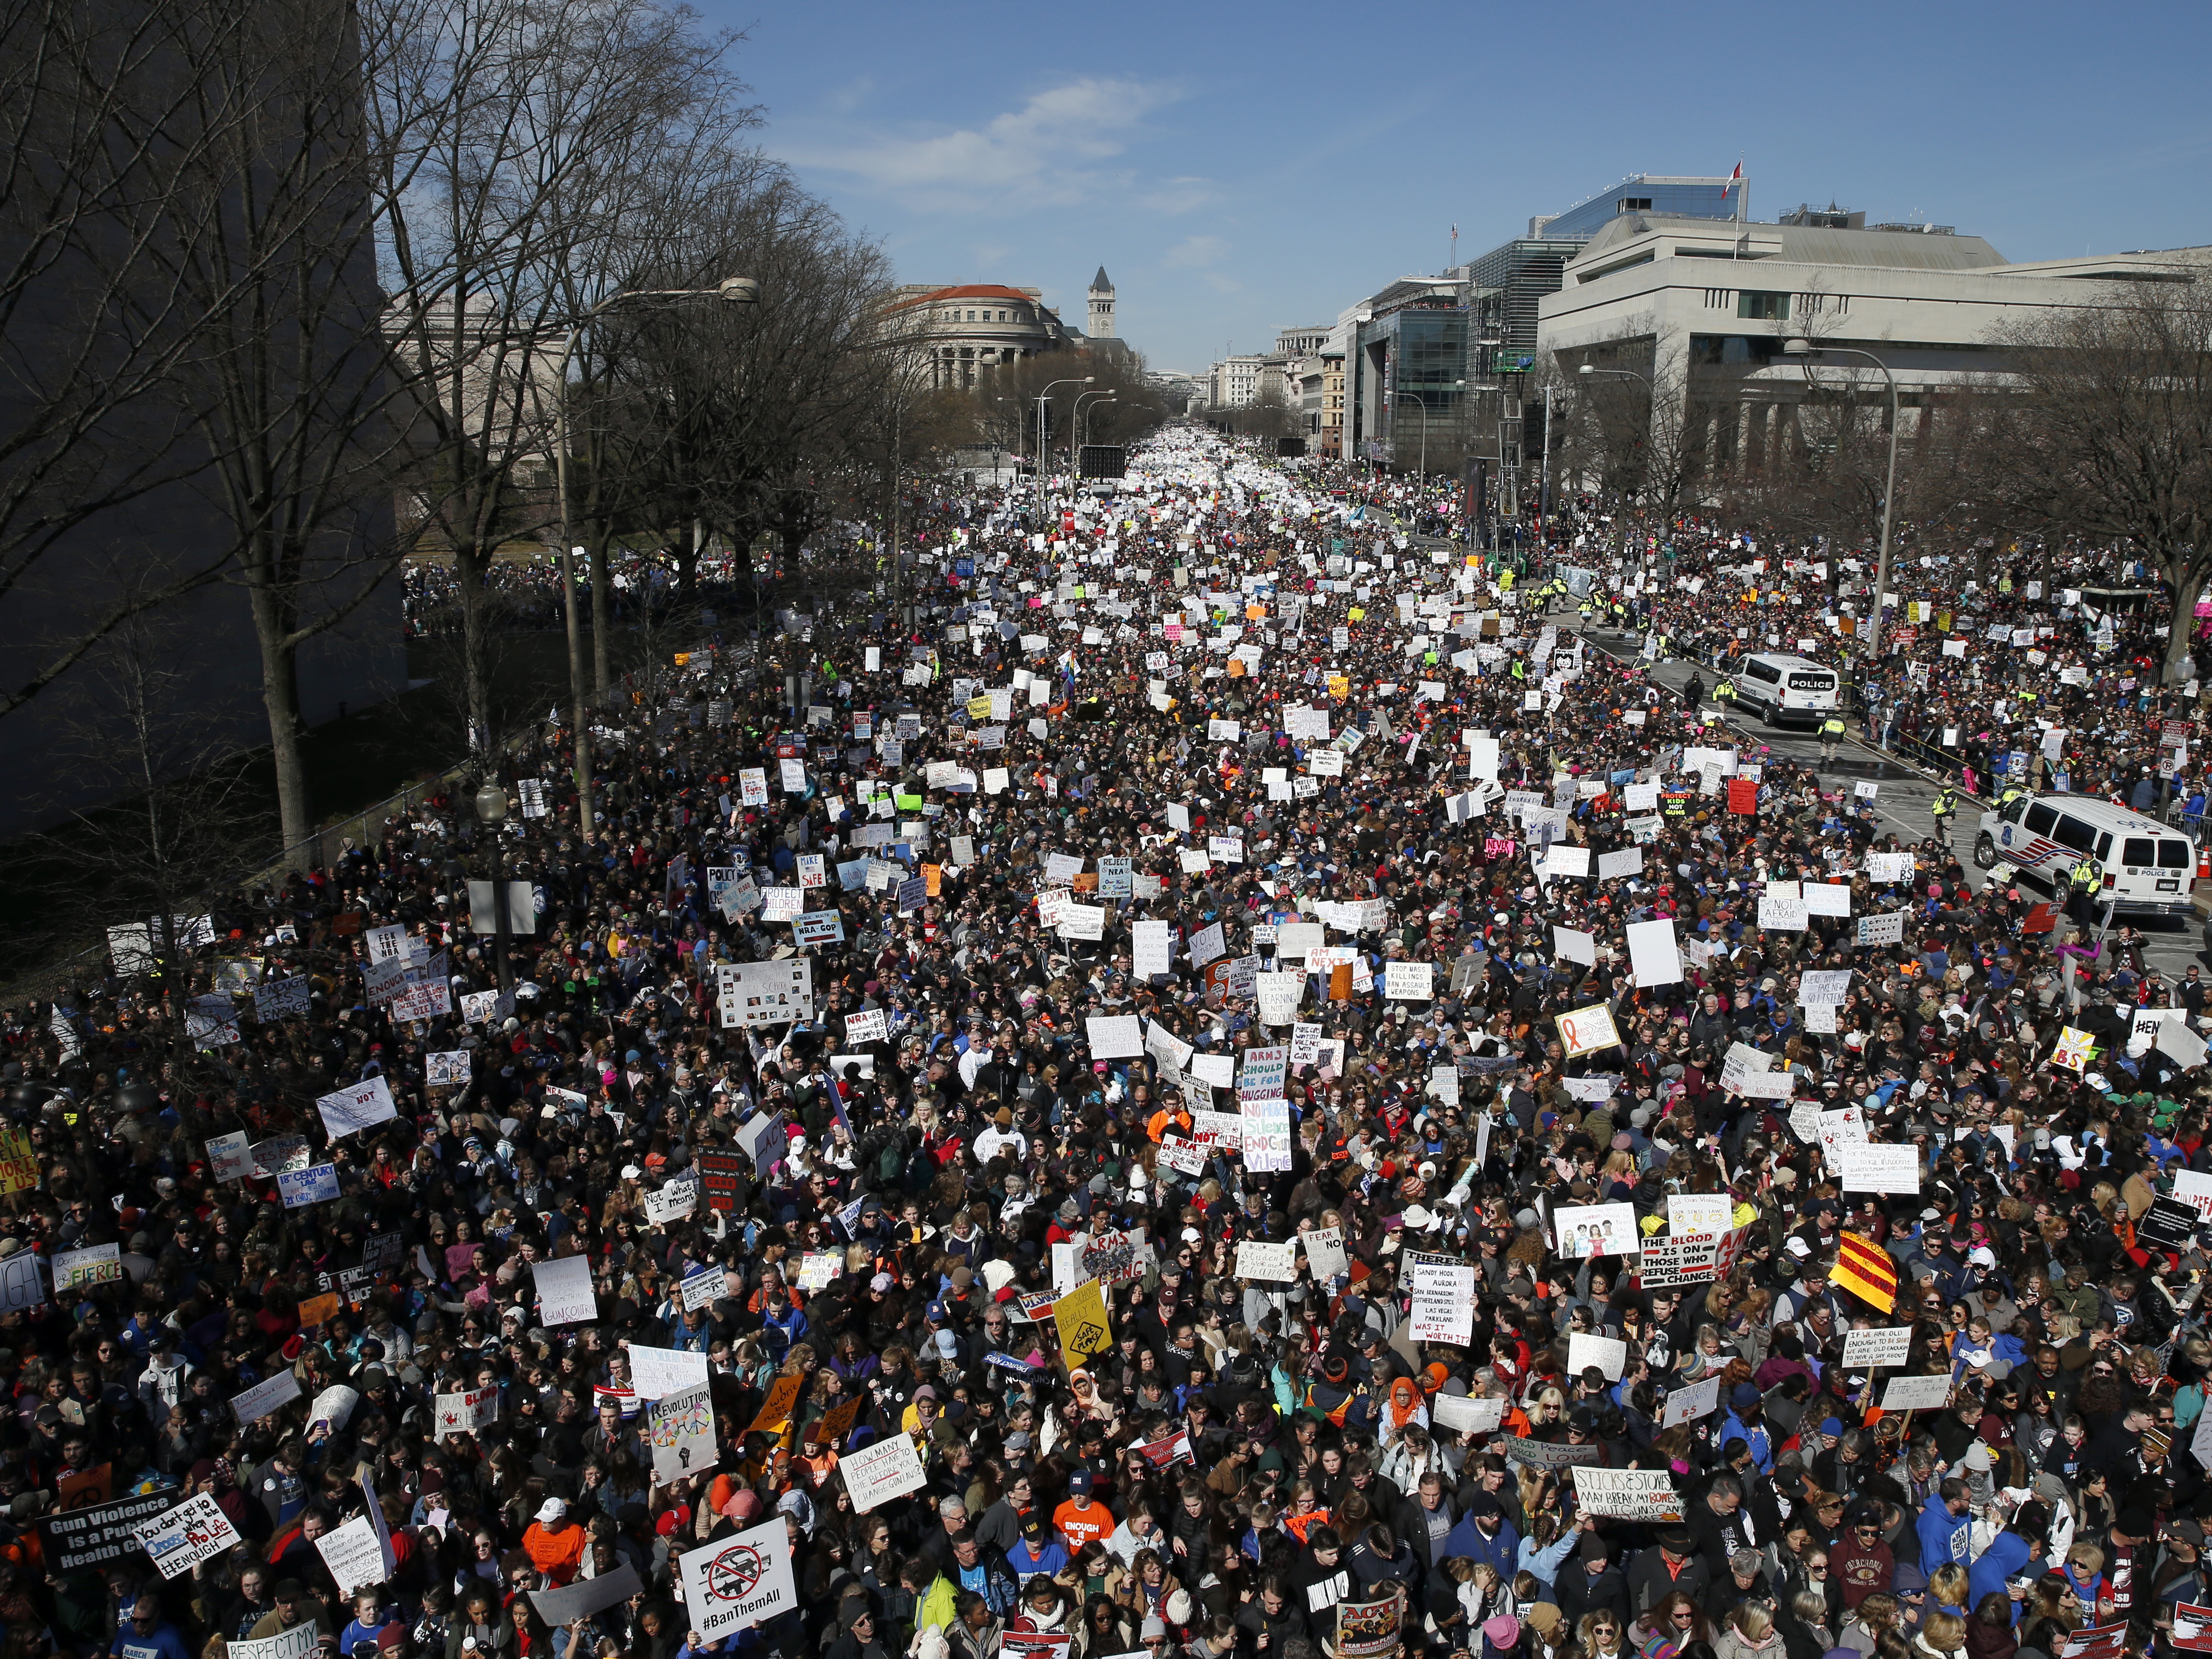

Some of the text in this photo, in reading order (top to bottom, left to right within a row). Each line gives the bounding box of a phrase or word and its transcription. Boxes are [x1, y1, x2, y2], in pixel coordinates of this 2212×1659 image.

[1153, 659, 1165, 668] NRA
[1742, 685, 1756, 696] POLICE
[1791, 680, 1832, 688] POLICE
[2116, 820, 2163, 830] 995
[1488, 839, 1509, 850] NEVER
[1227, 849, 1242, 857] Bullets
[801, 855, 818, 866] MAKE
[802, 873, 822, 886] SAFE
[762, 888, 802, 899] PROTECT
[761, 899, 803, 909] CHILDREN
[1774, 899, 1795, 910] NOT
[762, 910, 778, 920] NOT
[1765, 909, 1797, 918] AFRAID
[379, 932, 396, 942] FCK
[380, 940, 397, 949] THE
[381, 947, 399, 957] NRA
[258, 975, 307, 997] ENOUGH
[275, 992, 294, 1005] IS
[263, 997, 310, 1022] ENOUGH
[2069, 1030, 2085, 1045] I
[2059, 1040, 2086, 1057] CALL
[1250, 1050, 1282, 1063] ARMS
[2056, 1049, 2081, 1067] BS
[1243, 1063, 1283, 1075] SHOULD
[1244, 1075, 1281, 1087] BE FOR
[1241, 1087, 1282, 1102] HUGGING
[1644, 1234, 1713, 1247] THE BLOOD
[80, 1252, 88, 1261] be
[92, 1249, 118, 1259] afraid.
[1663, 1245, 1700, 1256] IS ON
[1644, 1255, 1708, 1266] THOSE WHO
[72, 1262, 122, 1287] FIERCE
[1643, 1267, 1680, 1276] REFUSE
[1668, 1272, 1712, 1283] CHANGE
[1059, 1284, 1099, 1314] IS SCHOOL
[1060, 1300, 1098, 1330] REALLY A
[1455, 1307, 1471, 1316] AR-15
[1455, 1316, 1471, 1325] AR-15
[1077, 1326, 1094, 1341] SAFE
[1426, 1332, 1469, 1345] WORTH IT?
[651, 1389, 709, 1422] REVOLUTION
[849, 1440, 900, 1469] HOW MANY
[851, 1448, 910, 1481] PEOPLE HAVE TO
[853, 1458, 913, 1492] DIE BEFORE YOU
[1576, 1470, 1626, 1490] STICKS
[1634, 1473, 1672, 1491] STONES
[858, 1482, 889, 1504] CHANGE
[889, 1475, 902, 1488] GUN
[1580, 1491, 1676, 1504] MAY BREAK MY BONES
[50, 1496, 169, 1535] Gun Violence
[1596, 1505, 1679, 1516] BUT GUNS CAN
[135, 1524, 161, 1541] You
[183, 1503, 197, 1523] get
[196, 1499, 210, 1510] to
[183, 1519, 207, 1535] when
[211, 1508, 219, 1516] be
[1065, 1522, 1099, 1533] ENOUGH
[68, 1535, 85, 1548] is
[89, 1532, 100, 1545] a
[145, 1533, 186, 1556] Choose
[186, 1531, 209, 1548] Pro
[206, 1519, 228, 1537] Life
[61, 1545, 120, 1568] Health
[161, 1541, 220, 1576] #ENOUGH
[703, 1588, 780, 1631] #BanThemAll
[1343, 1597, 1399, 1619] ACT!
[1380, 1632, 1396, 1643] PLACE
